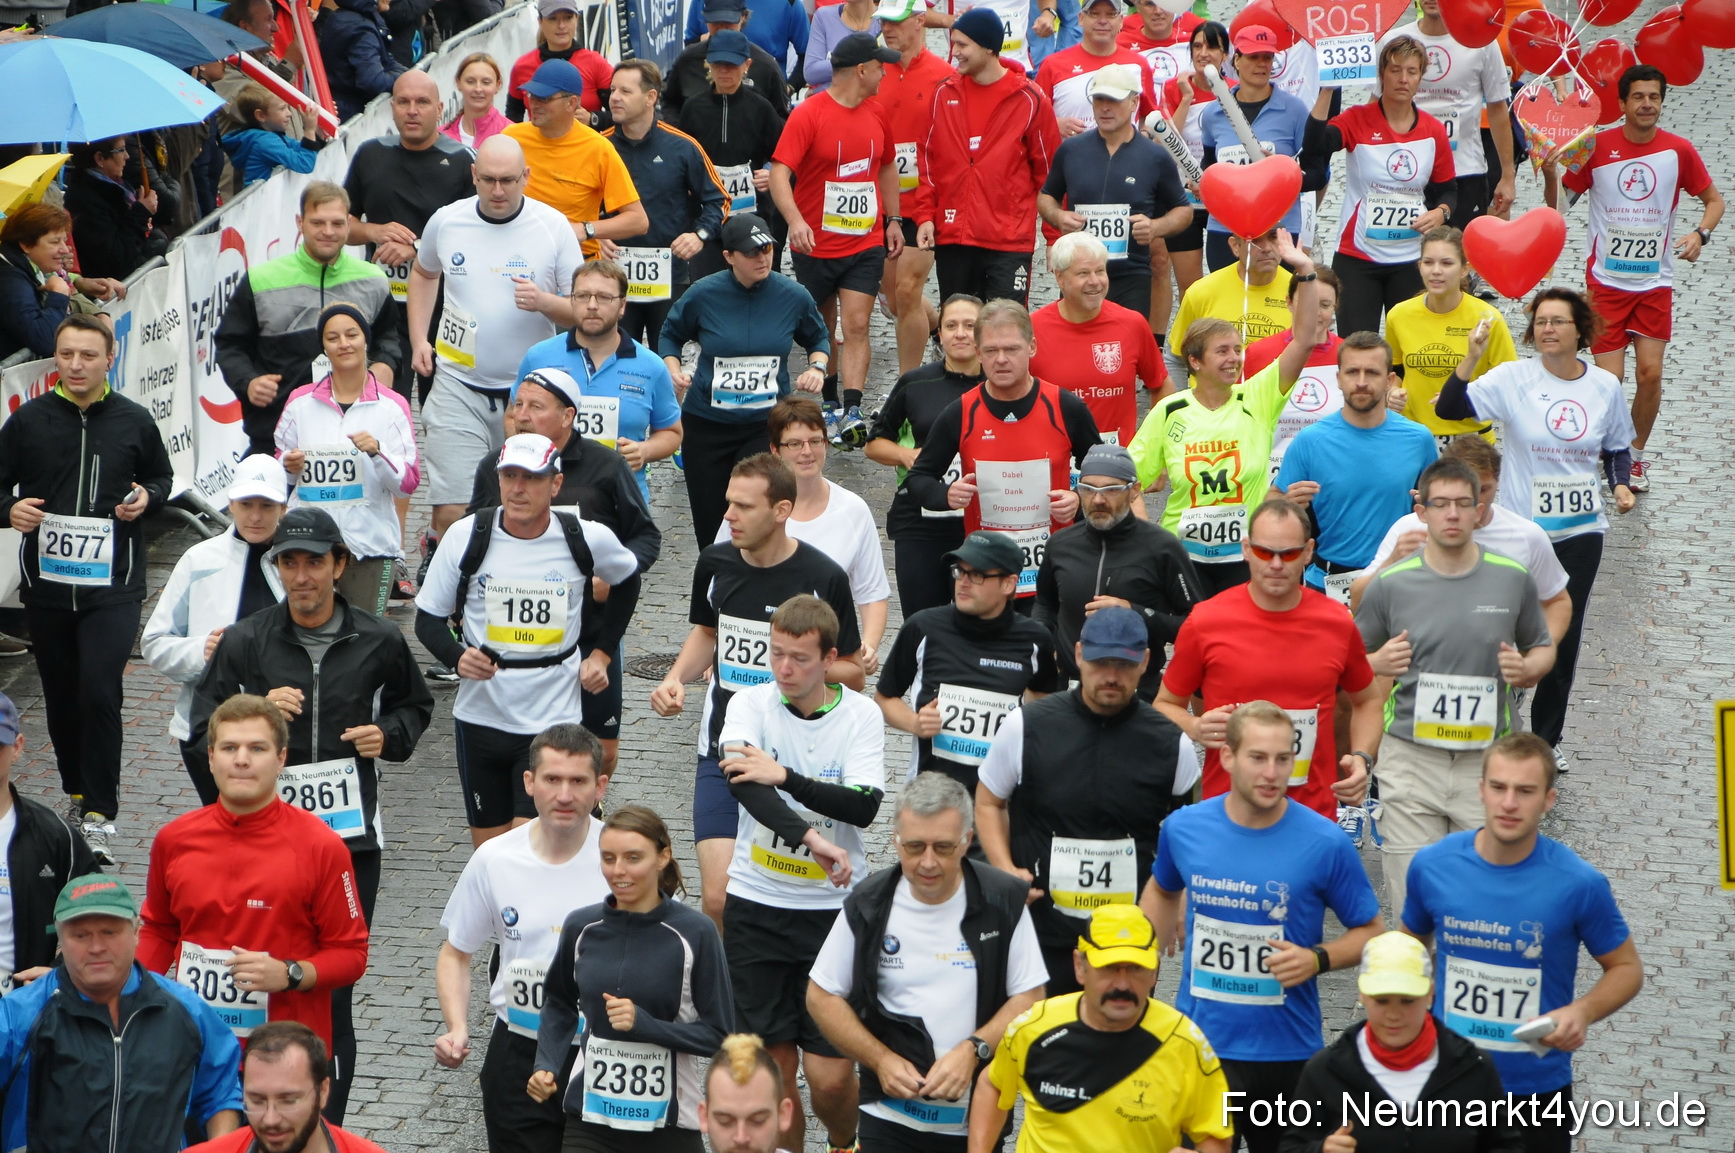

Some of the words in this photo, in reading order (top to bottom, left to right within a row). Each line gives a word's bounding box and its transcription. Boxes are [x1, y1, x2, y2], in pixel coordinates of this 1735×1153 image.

[1306, 4, 1382, 38] ROSI
[1316, 40, 1336, 48] PARTL
[1336, 36, 1366, 47] Neumarkt
[1322, 45, 1373, 66] 3333
[1163, 132, 1188, 159] BMW
[836, 195, 869, 214] 208
[1368, 197, 1388, 205] PARTL
[1091, 209, 1119, 217] Neumarkt
[1372, 206, 1421, 227] 2725
[841, 218, 862, 229] Mario
[1607, 228, 1626, 237] PARTL
[1627, 230, 1655, 238] Neumarkt
[1387, 230, 1402, 240] Eva
[633, 252, 661, 261] Neumarkt
[1610, 238, 1658, 259] 2723
[624, 261, 660, 282] 103
[1613, 262, 1650, 273] Johannes
[628, 285, 652, 296] Alfred
[1013, 276, 1026, 291] 53
[442, 318, 466, 348] 557
[1419, 344, 1453, 356] PIZZERIA
[738, 361, 770, 369] Neumarkt
[1411, 354, 1459, 367] FRANCESCO
[719, 370, 771, 392] 2551
[576, 412, 604, 436] 53
[316, 449, 349, 458] Neumarkt
[1184, 439, 1239, 457] Müller
[1531, 444, 1561, 455] LAUFEN
[1563, 448, 1578, 456] MIT
[301, 459, 357, 484] 3029
[1001, 471, 1024, 480] Dabei
[1200, 468, 1230, 495] M
[1533, 481, 1557, 489] PARTL
[1558, 480, 1590, 489] Neumarkt
[319, 489, 337, 501] Eva
[1004, 488, 1025, 497] Dank
[1539, 489, 1595, 515] 3193
[992, 502, 1041, 514] Organspende
[1182, 511, 1203, 521] PARTL
[1203, 510, 1236, 520] Neumarkt
[42, 518, 63, 530] PARTL
[64, 522, 101, 533] Neumarkt
[1184, 520, 1242, 544] 2046
[45, 531, 106, 561] 2677
[1203, 546, 1220, 558] Iris
[54, 562, 93, 578] andreas
[486, 584, 514, 595] PARTL
[514, 587, 554, 597] Neumarkt
[502, 597, 552, 625] 188
[719, 621, 742, 632] PARTL
[513, 630, 536, 643] Udo
[723, 634, 769, 667] 252
[987, 658, 1024, 672] PFLEIDERER
[1419, 680, 1446, 691] PARTL
[1447, 683, 1485, 692] Neumarkt
[939, 690, 966, 704] PARTL
[966, 696, 1007, 710] Neumarkt
[1431, 693, 1482, 722] 417
[1436, 726, 1473, 741] Dennis
[301, 767, 343, 781] Neumarkt
[281, 778, 350, 813] 2861
[1052, 845, 1083, 857] PARTL
[1083, 847, 1124, 858] Neumarkt
[765, 854, 809, 877] Thomas
[1077, 859, 1113, 889] 54
[1191, 873, 1259, 895] Kirwaläufer
[341, 870, 360, 920] SIEMENS
[1194, 921, 1221, 937] PARTL
[1222, 929, 1267, 943] Neumarkt
[1443, 915, 1512, 937] Kirwaläufer
[880, 955, 905, 966] PARTL
[1199, 937, 1271, 975] 2616
[1447, 963, 1476, 978] PARTL
[1477, 971, 1524, 987] Neumarkt
[186, 966, 259, 1005] 3032
[1210, 976, 1260, 995] Michael
[1452, 980, 1531, 1020] 2617
[1467, 1021, 1506, 1040] Jakob
[587, 1043, 615, 1060] PARTL
[616, 1049, 663, 1062] Neumarkt
[591, 1059, 667, 1097] 2383
[1039, 1081, 1077, 1099] Heinz
[1077, 1087, 1093, 1101] L.
[601, 1099, 651, 1120] Theresa
[903, 1099, 940, 1123] Gerald
